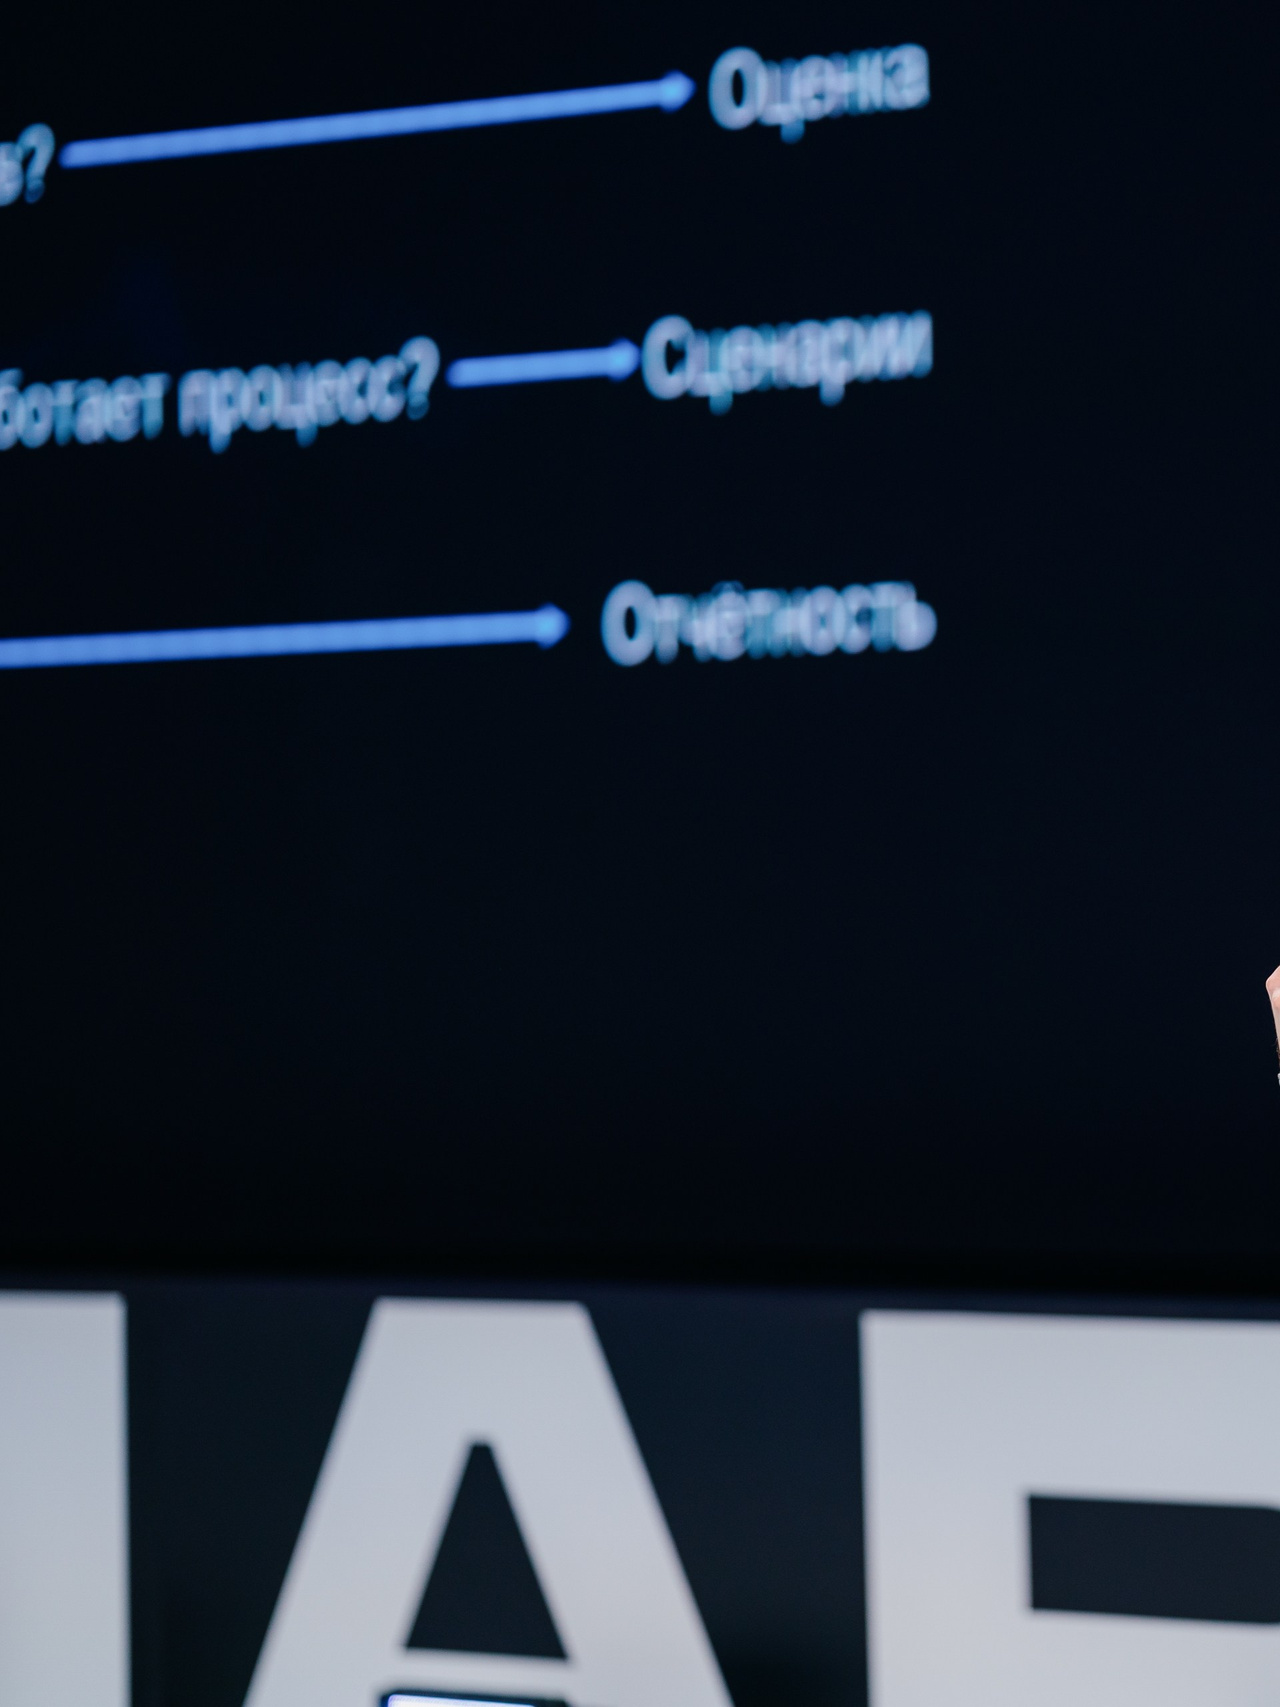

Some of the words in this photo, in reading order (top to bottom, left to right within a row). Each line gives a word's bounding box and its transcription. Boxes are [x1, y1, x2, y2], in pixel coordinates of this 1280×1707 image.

[708, 42, 931, 142] Оценка
[177, 335, 441, 454] процесс?
[640, 309, 934, 414] Сценарии
[600, 579, 938, 668] Отчётность
